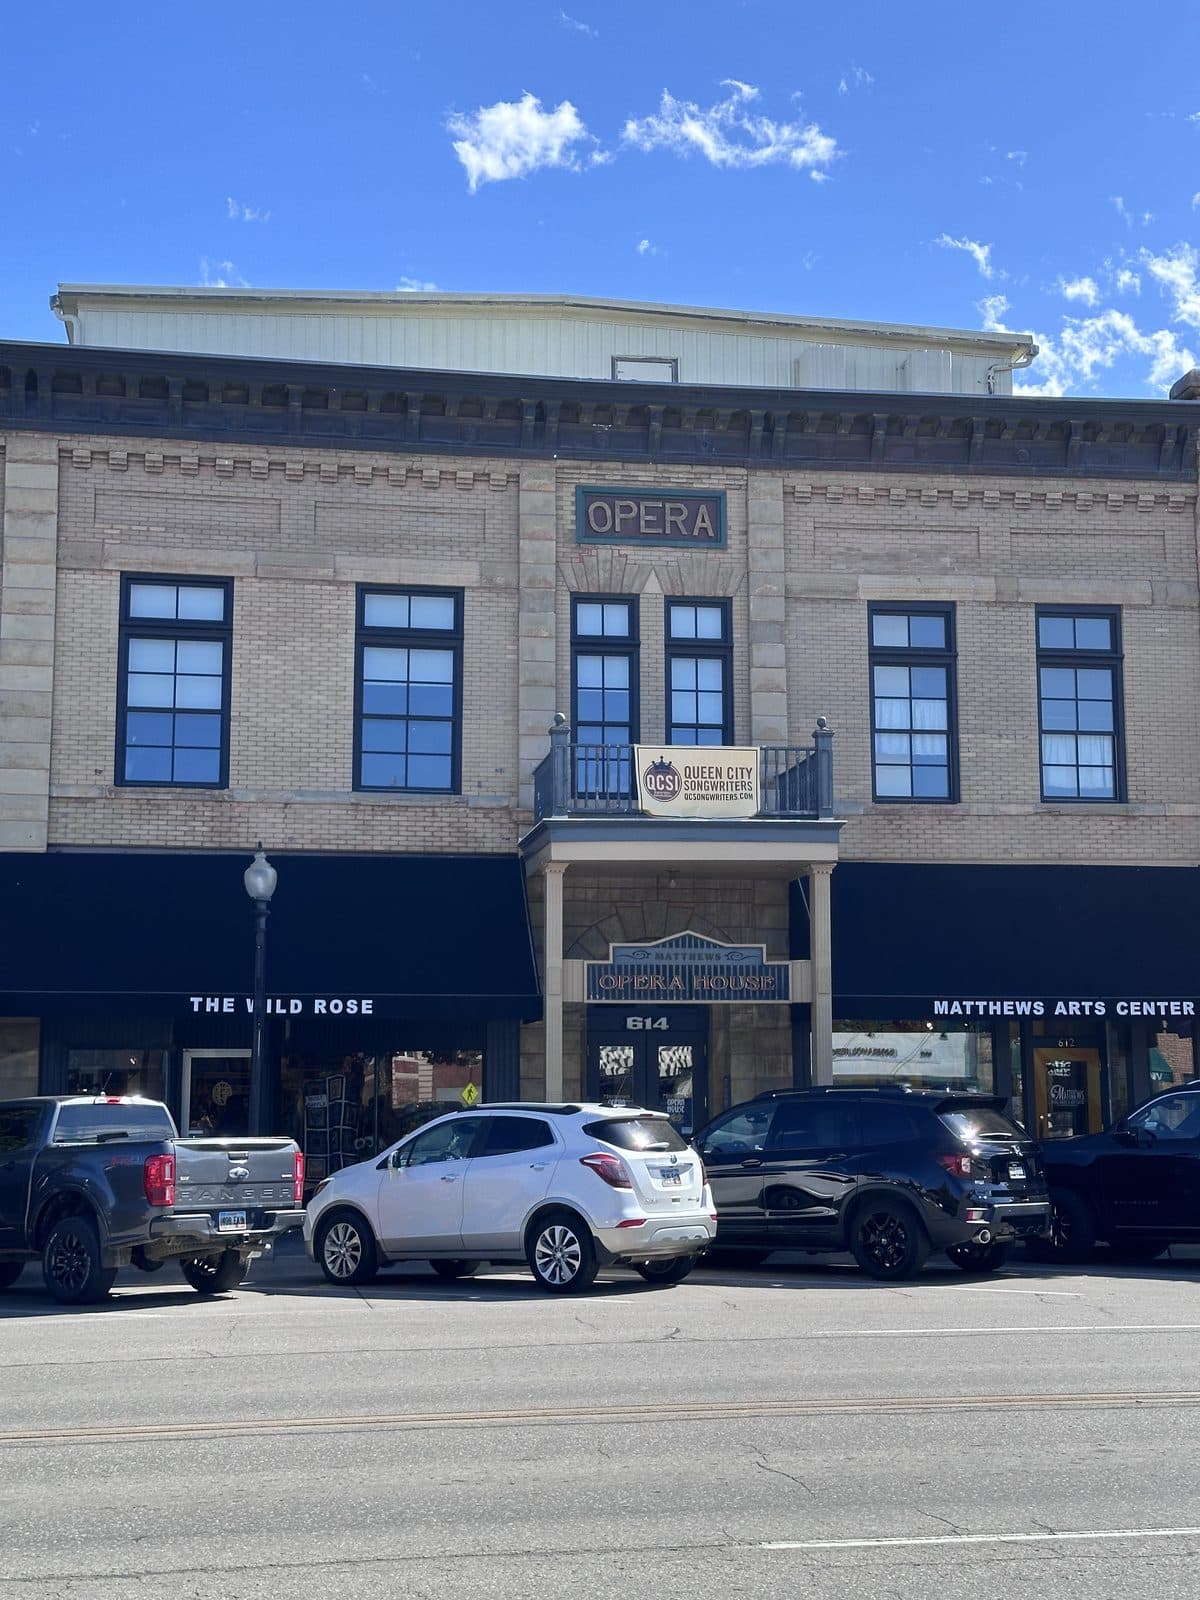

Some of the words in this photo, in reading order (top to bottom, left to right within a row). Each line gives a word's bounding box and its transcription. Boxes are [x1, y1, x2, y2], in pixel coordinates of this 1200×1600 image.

[588, 500, 714, 537] OPERA
[684, 766, 722, 779] QUEEN
[727, 767, 753, 780] CITY
[684, 780, 753, 792] SONGWRITERS
[684, 793, 753, 801] QCSONGWRITERS.COM
[655, 952, 721, 961] MATTHEWS
[599, 974, 685, 991] OPERA
[693, 975, 776, 991] HOUSE
[190, 997, 235, 1012] THE
[314, 999, 373, 1014] ROSE
[934, 1001, 1045, 1016] MATTHEWS
[1054, 1001, 1106, 1016] ARTS
[1116, 1001, 1195, 1016] CENTER
[626, 1016, 669, 1030] 614
[179, 1186, 292, 1201] RANGER
